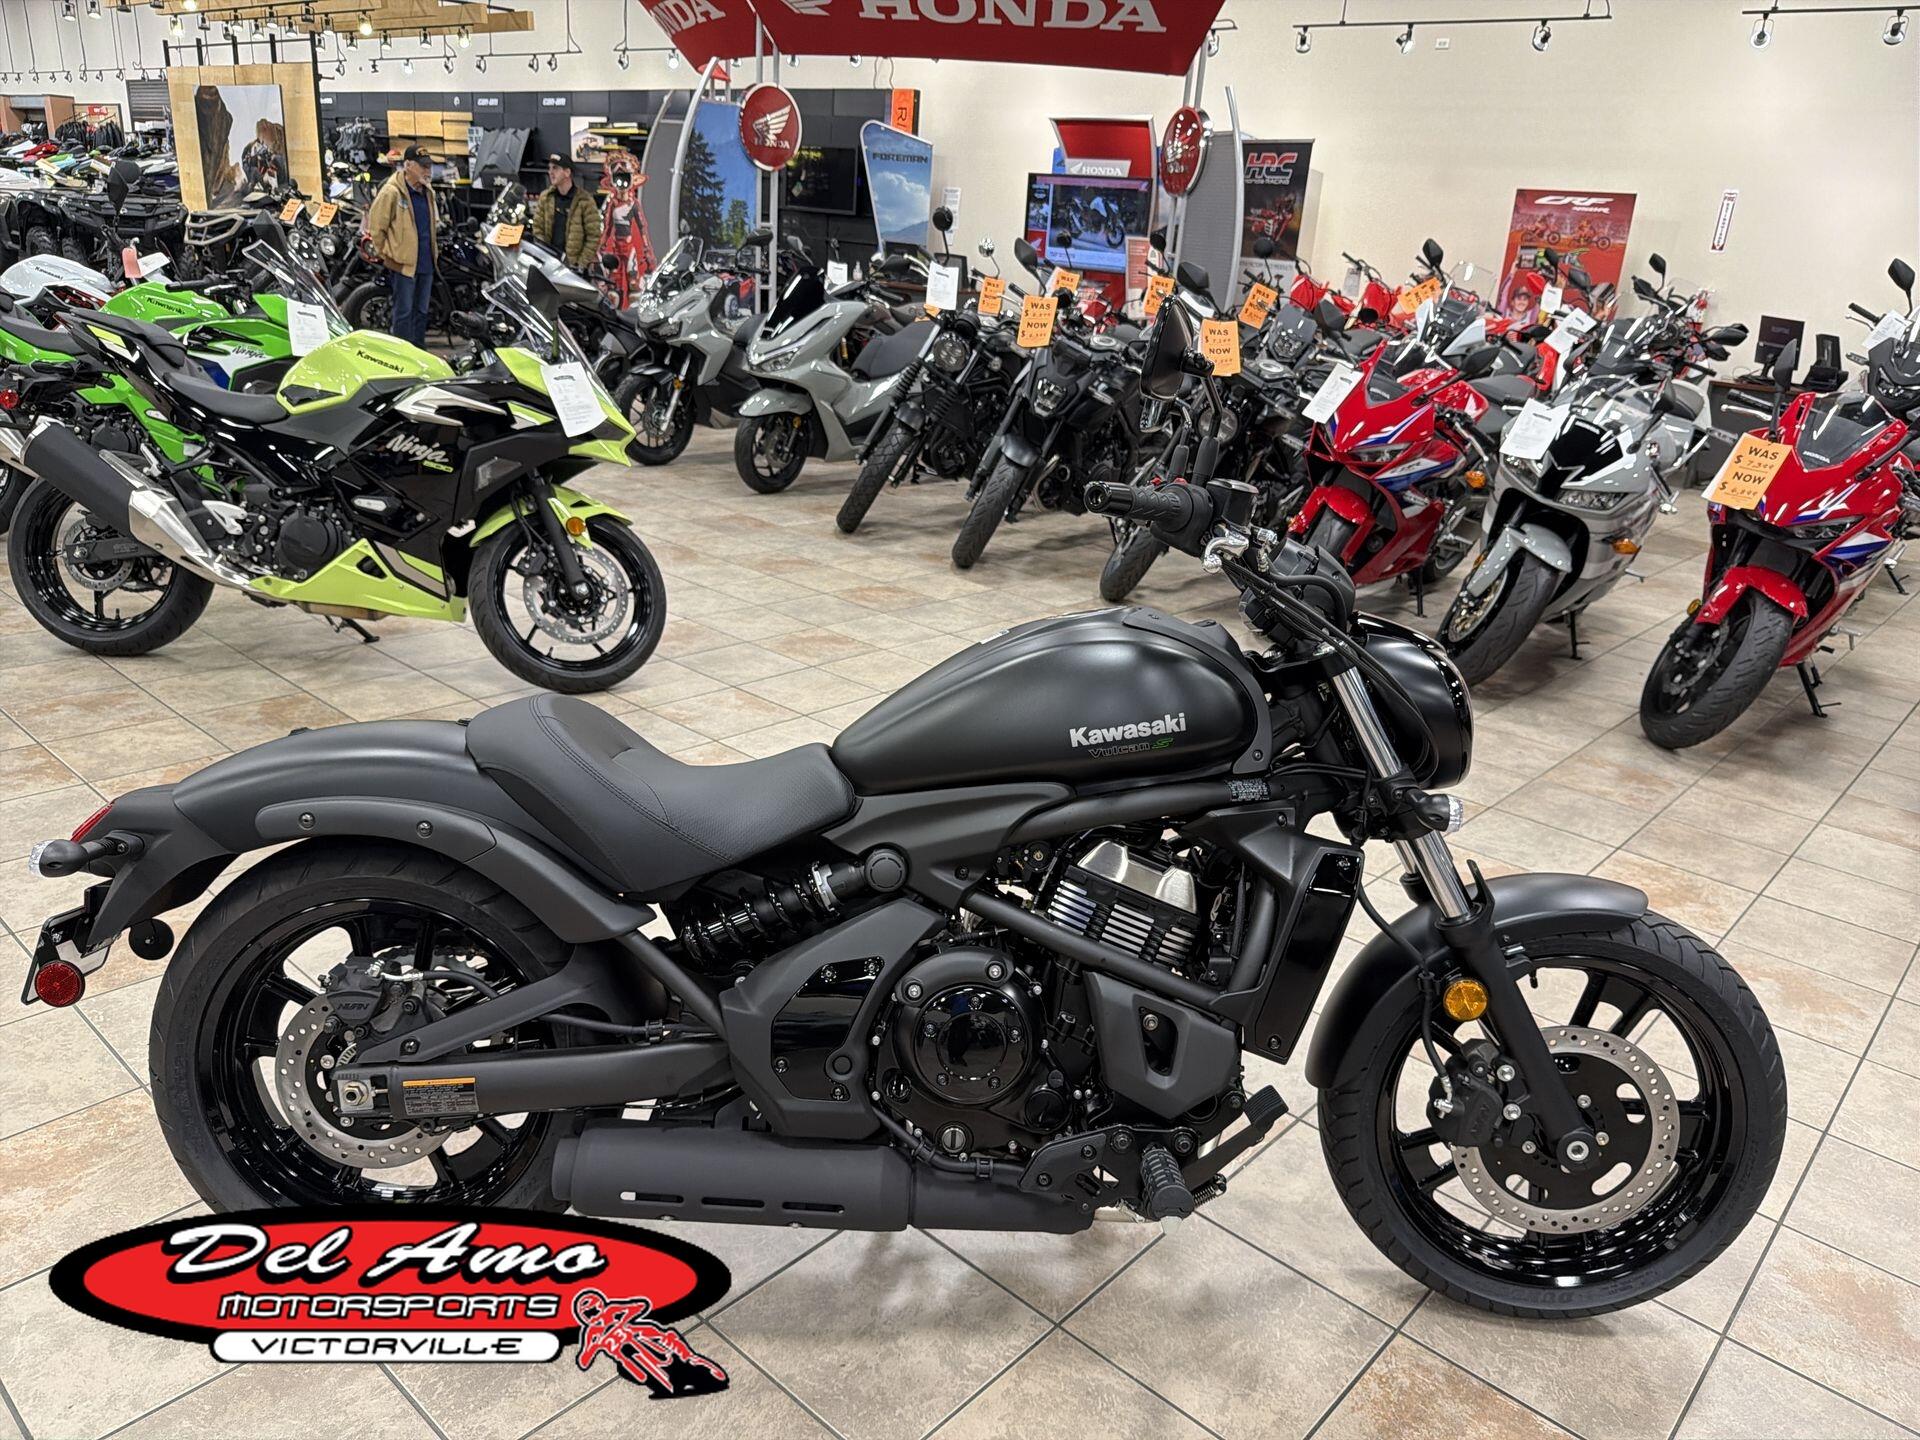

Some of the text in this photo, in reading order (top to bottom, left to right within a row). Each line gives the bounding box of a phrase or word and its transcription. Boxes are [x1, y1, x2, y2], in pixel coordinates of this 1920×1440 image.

[872, 152, 928, 164] FOREMAN
[1082, 166, 1122, 177] HONDA
[1244, 152, 1298, 179] HRC
[1534, 195, 1615, 206] CRF
[1030, 302, 1051, 310] WAS
[1026, 321, 1048, 329] NOW
[1208, 328, 1229, 336] WAS
[1208, 347, 1231, 355] NOW
[356, 349, 405, 373] Kawasaki
[385, 433, 450, 462] Ninja
[1748, 446, 1780, 460] WAS
[1732, 471, 1766, 485] NOW
[1069, 712, 1186, 748] Kawasaki
[1088, 742, 1150, 758] Vulcan
